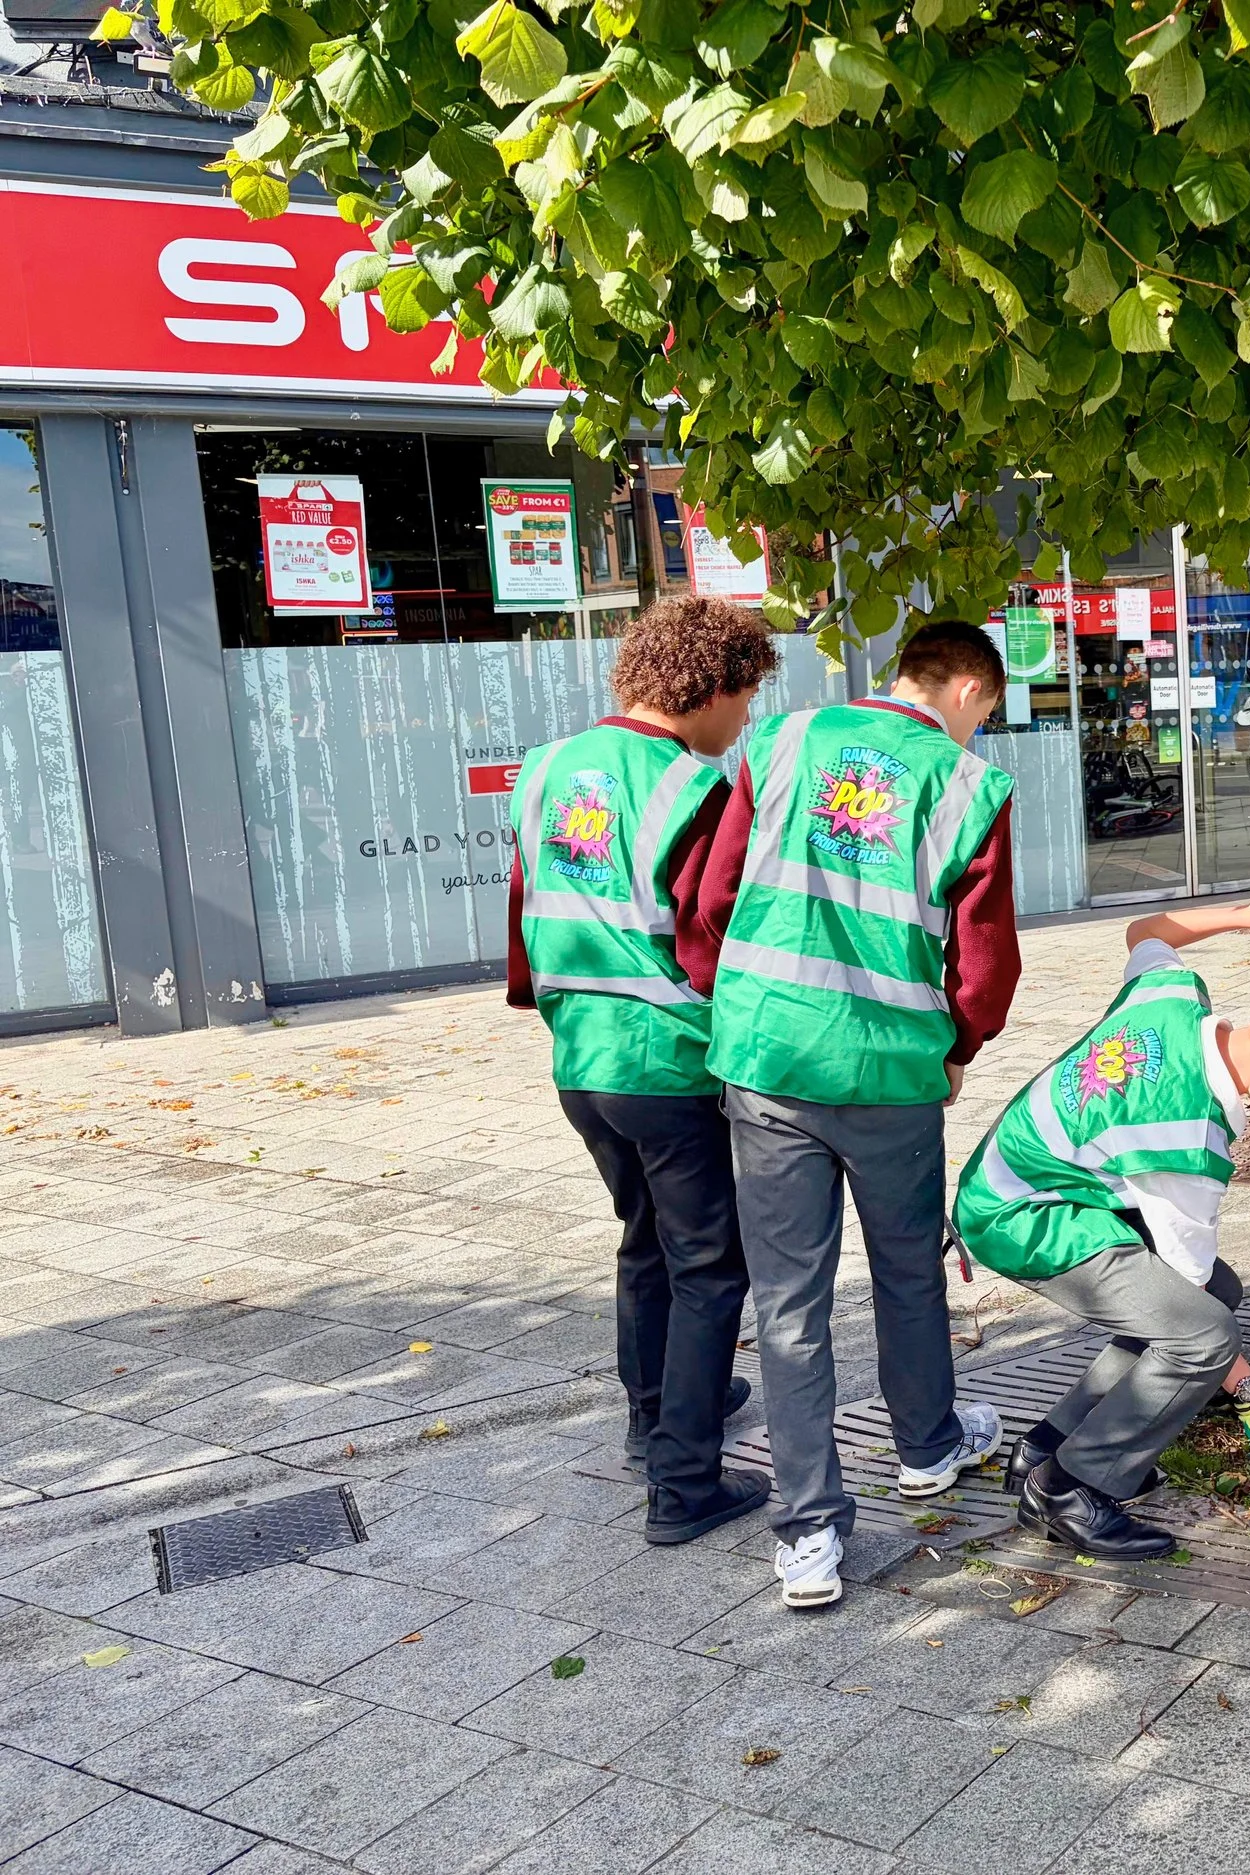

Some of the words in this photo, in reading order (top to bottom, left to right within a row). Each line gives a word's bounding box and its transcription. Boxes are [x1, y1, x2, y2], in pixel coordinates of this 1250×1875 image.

[489, 495, 519, 506] SAVE
[522, 497, 552, 507] FROM
[553, 498, 566, 507] €1
[291, 511, 306, 524] RED
[307, 512, 332, 525] VALUE
[329, 537, 353, 546] €2.50
[291, 553, 315, 564] ishka
[529, 566, 543, 577] SPAR
[296, 577, 317, 585] ISHKA
[405, 607, 467, 623] INSOMNIA
[1153, 684, 1177, 692] Automatic
[1191, 683, 1215, 691] Automatic
[465, 744, 527, 759] UNDER
[841, 746, 910, 779] RANELAGH
[828, 780, 894, 823] POP
[564, 807, 609, 842] POP
[359, 834, 441, 858] GLAD
[807, 830, 841, 856] PRIDE
[840, 844, 859, 862] OF
[856, 848, 890, 865] PLACE
[549, 858, 581, 878] PRIDE
[581, 867, 592, 881] OF
[441, 873, 489, 895] your
[1094, 1039, 1126, 1084] POP
[1138, 1028, 1163, 1085] RANELAGH
